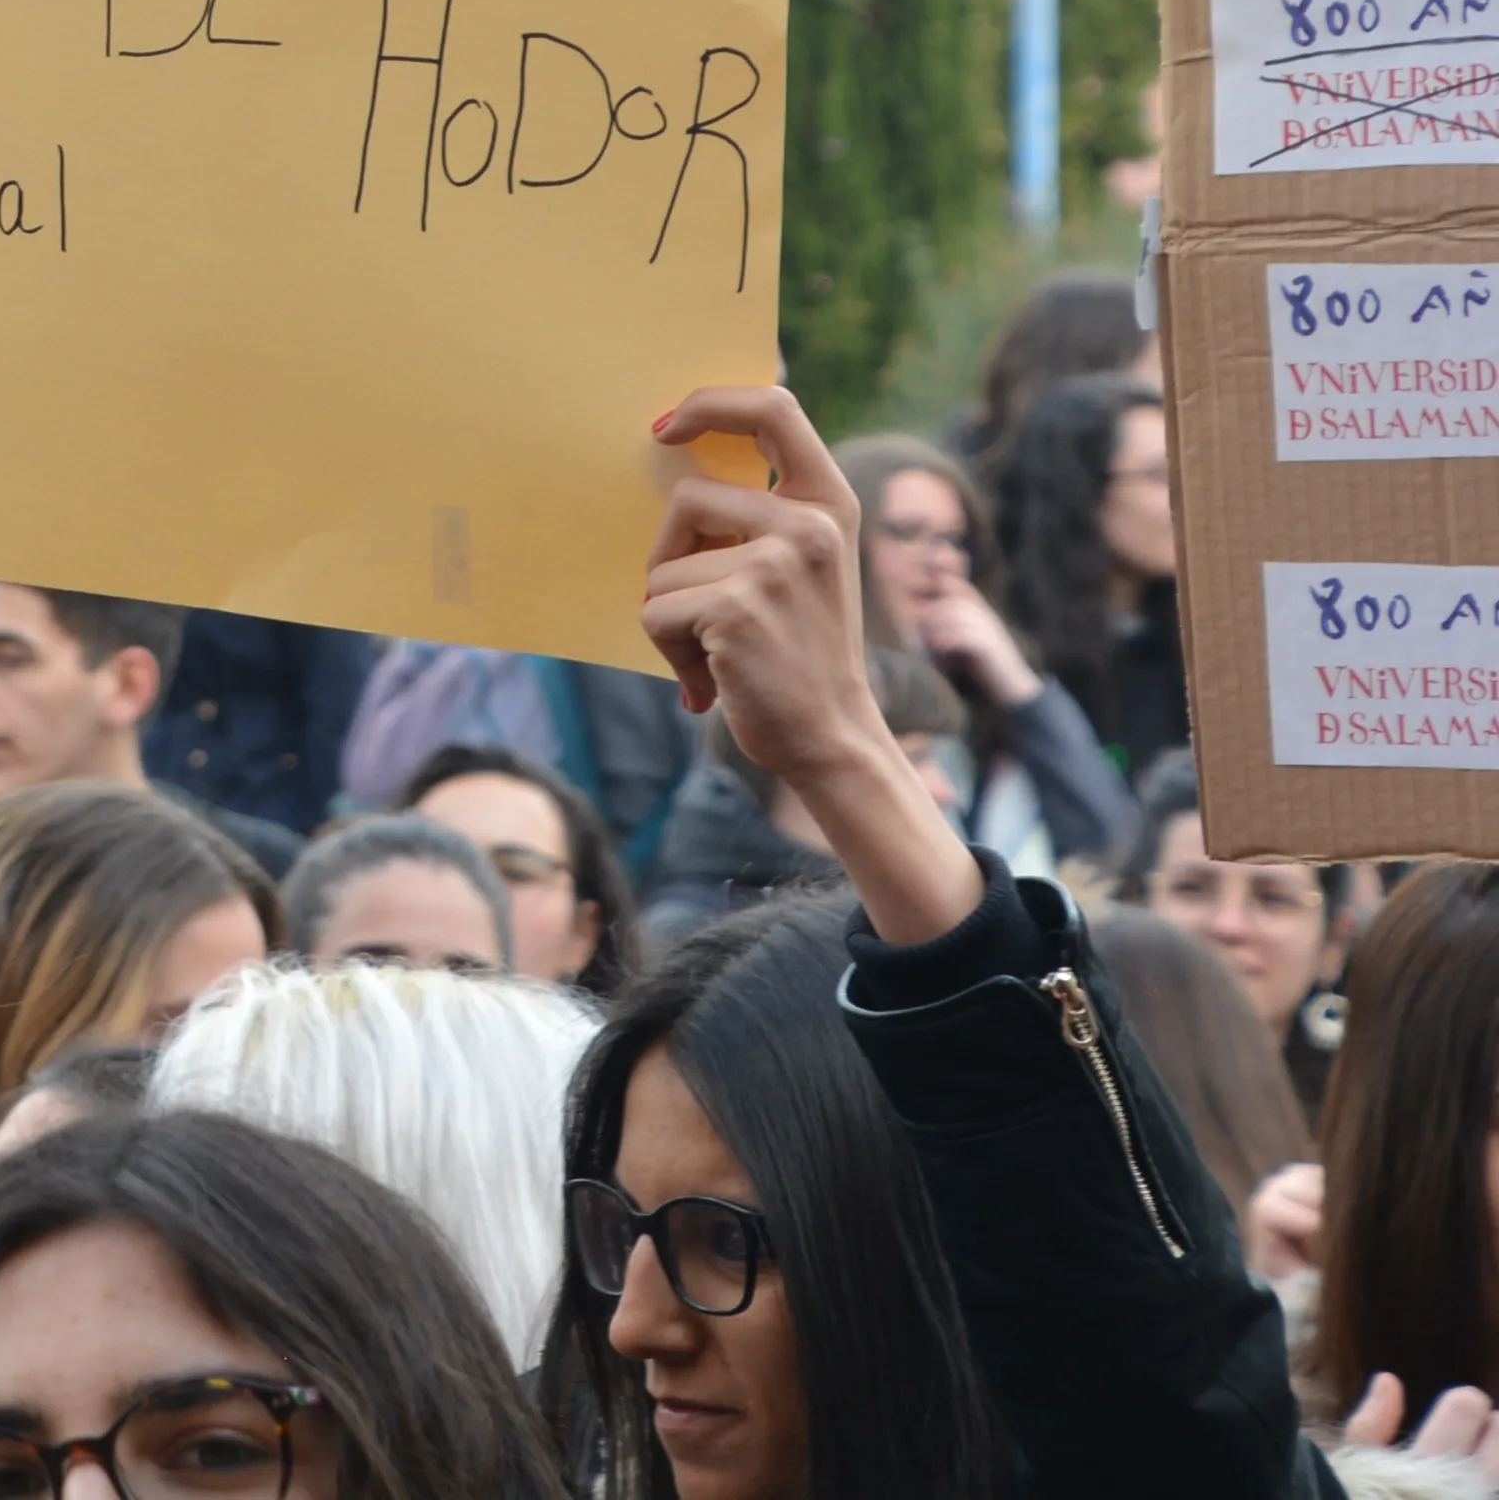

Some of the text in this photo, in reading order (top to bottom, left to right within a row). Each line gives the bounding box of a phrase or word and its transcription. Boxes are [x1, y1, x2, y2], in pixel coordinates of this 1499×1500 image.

[1279, 274, 1382, 337] 800
[1308, 576, 1499, 640] 800 A
